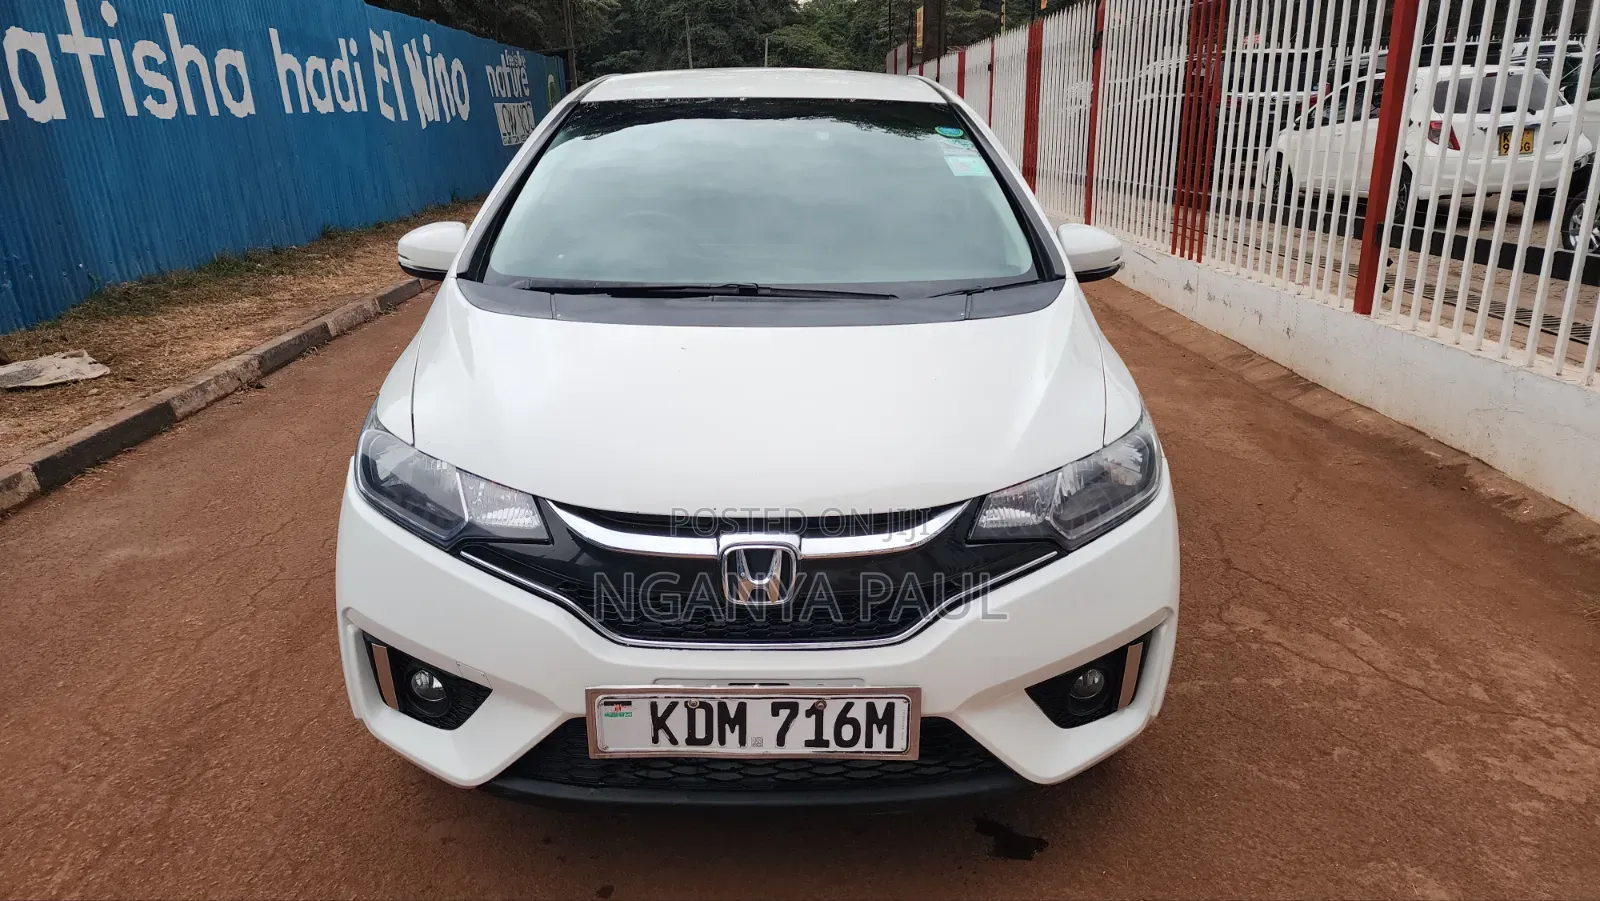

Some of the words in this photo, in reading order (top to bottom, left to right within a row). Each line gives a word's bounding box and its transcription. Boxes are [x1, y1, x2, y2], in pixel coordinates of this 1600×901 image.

[0, 0, 256, 124] atisha
[269, 28, 368, 115] hadi
[369, 28, 408, 122] El
[403, 33, 470, 129] Nino
[485, 54, 530, 98] nature
[650, 699, 748, 749] KDM
[771, 700, 896, 750] 716M
